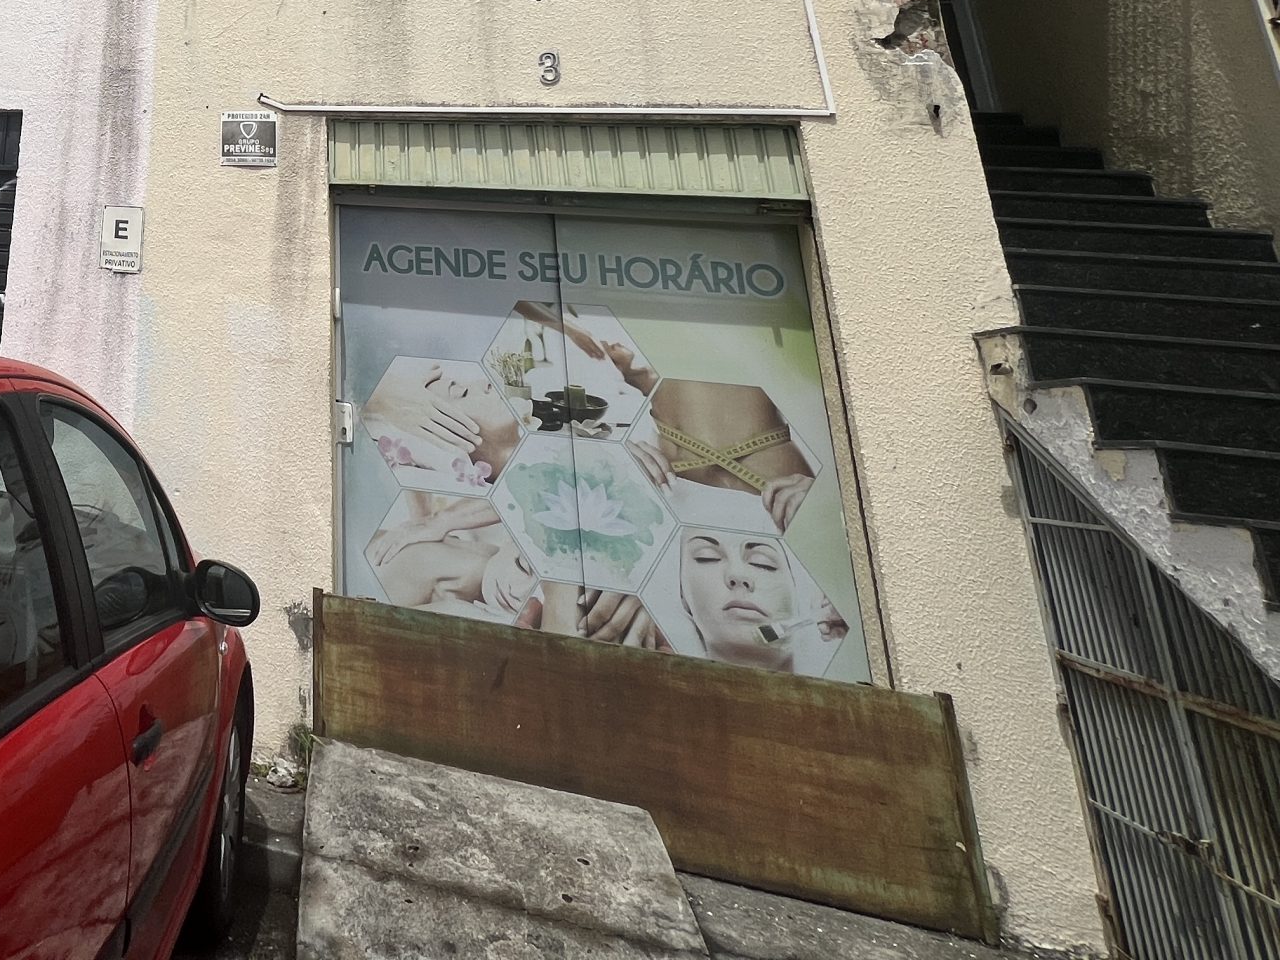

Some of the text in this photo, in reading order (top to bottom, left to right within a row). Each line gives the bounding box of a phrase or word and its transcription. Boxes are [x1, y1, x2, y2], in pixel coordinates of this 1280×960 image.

[538, 52, 561, 86] 3
[114, 219, 129, 240] E
[104, 259, 136, 268] PRIVATIVO
[363, 243, 785, 297] AGENDE SEU HORÁRIO
